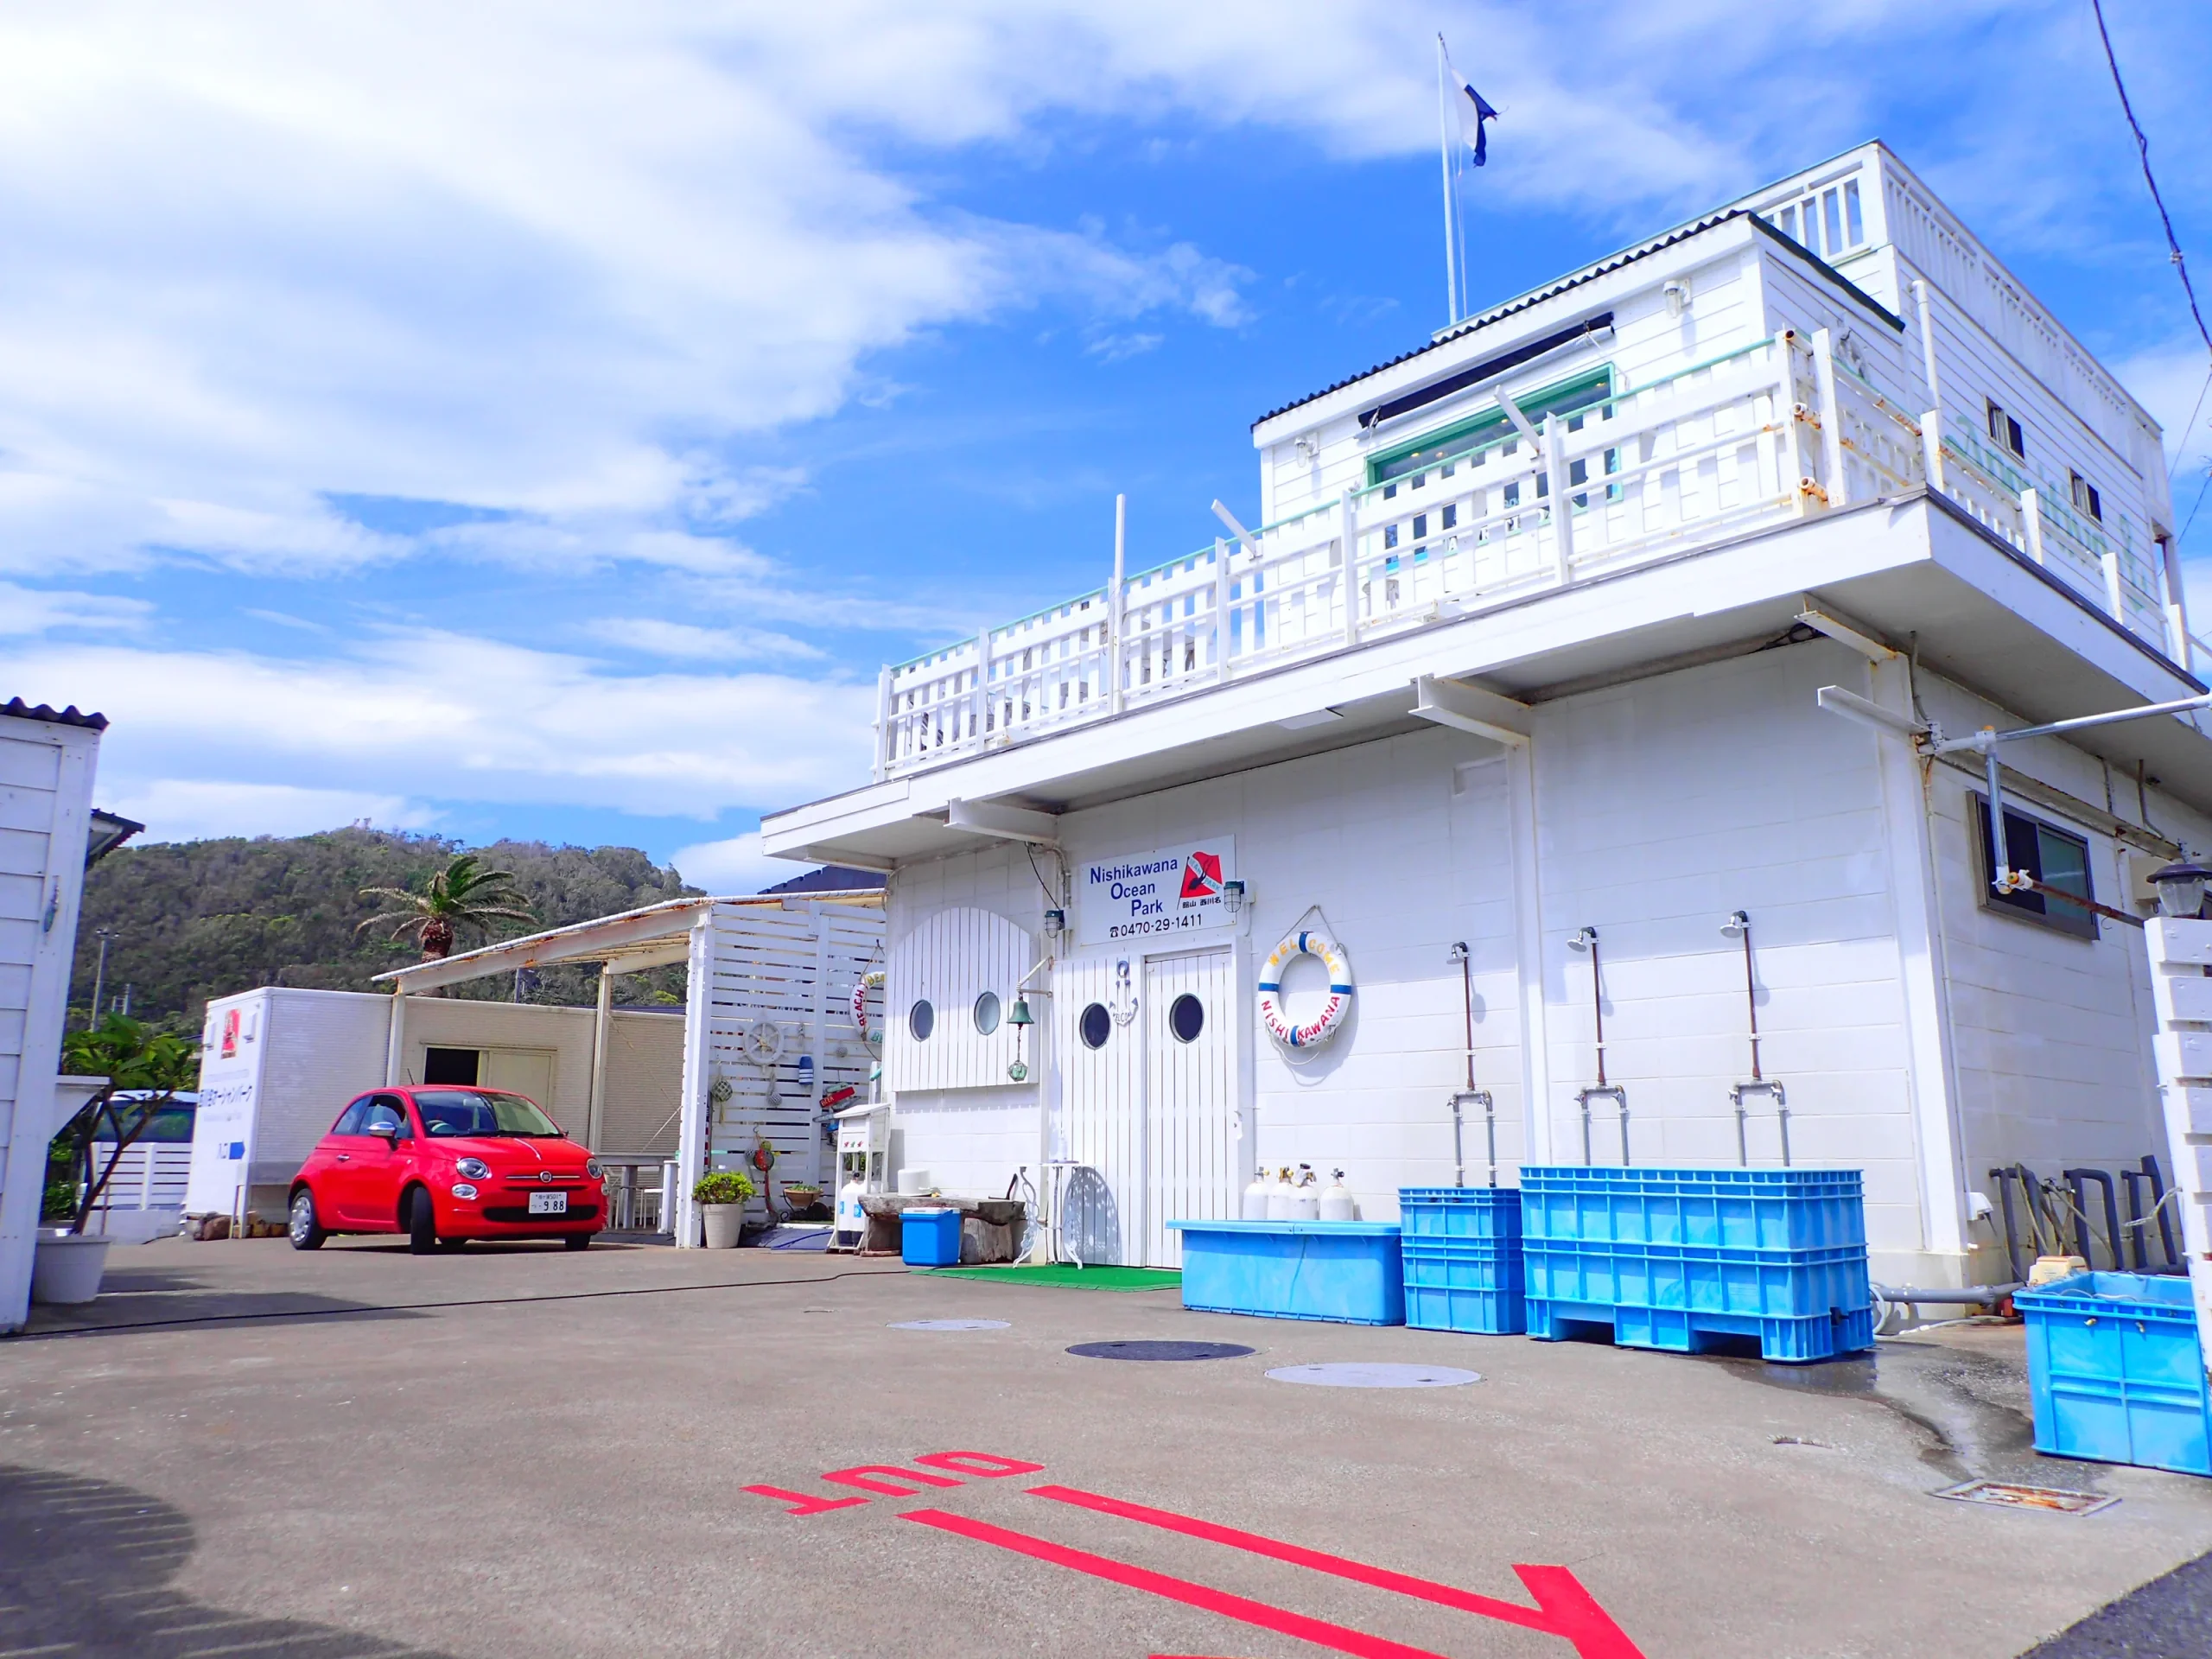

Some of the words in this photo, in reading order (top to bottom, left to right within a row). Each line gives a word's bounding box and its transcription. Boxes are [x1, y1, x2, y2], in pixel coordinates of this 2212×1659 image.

[1090, 859, 1178, 885] Nishikawana
[1111, 882, 1155, 900] Ocean
[1199, 896, 1222, 906] 西川名
[1131, 899, 1164, 917] Park
[1121, 913, 1202, 937] 0470-29-1411
[854, 989, 867, 1027] BEACH
[739, 1451, 1046, 1516] OUT
